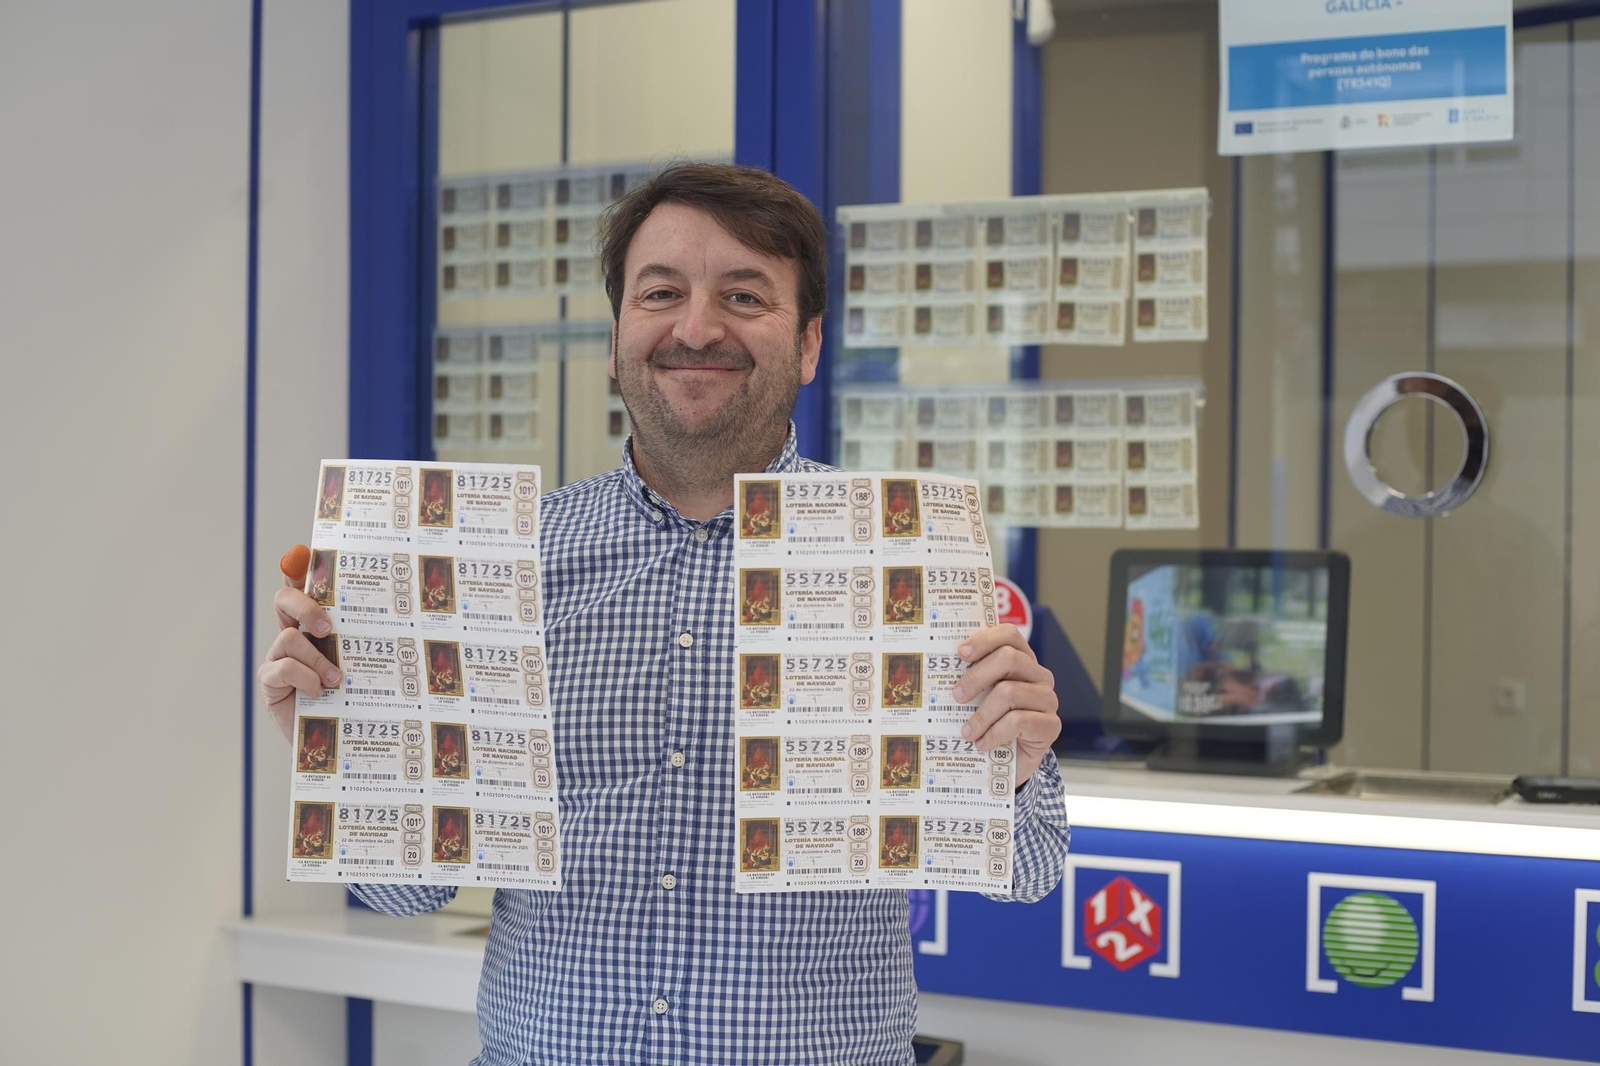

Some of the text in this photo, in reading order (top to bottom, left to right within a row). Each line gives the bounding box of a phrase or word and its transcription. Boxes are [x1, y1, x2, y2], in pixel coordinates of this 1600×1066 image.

[1326, 0, 1391, 14] GALICIA
[1300, 51, 1357, 65] Programa
[1408, 44, 1430, 56] das
[349, 472, 392, 483] 81725
[456, 475, 511, 489] 81725
[786, 485, 847, 496] 55725
[922, 484, 963, 500] 55725
[338, 557, 389, 570] 81725
[458, 563, 513, 577] 81725
[786, 573, 847, 584] 55725
[928, 570, 976, 583] 55725
[342, 639, 395, 653] 81725
[463, 648, 519, 662] 81725
[786, 658, 846, 669] 55725
[343, 723, 400, 736] 81725
[471, 730, 526, 745] 81725
[786, 740, 845, 751] 55725
[926, 739, 982, 752] 5572
[339, 808, 399, 821] 81725
[474, 813, 531, 828] 81725
[785, 821, 844, 832] 55725
[924, 820, 984, 834] 55725
